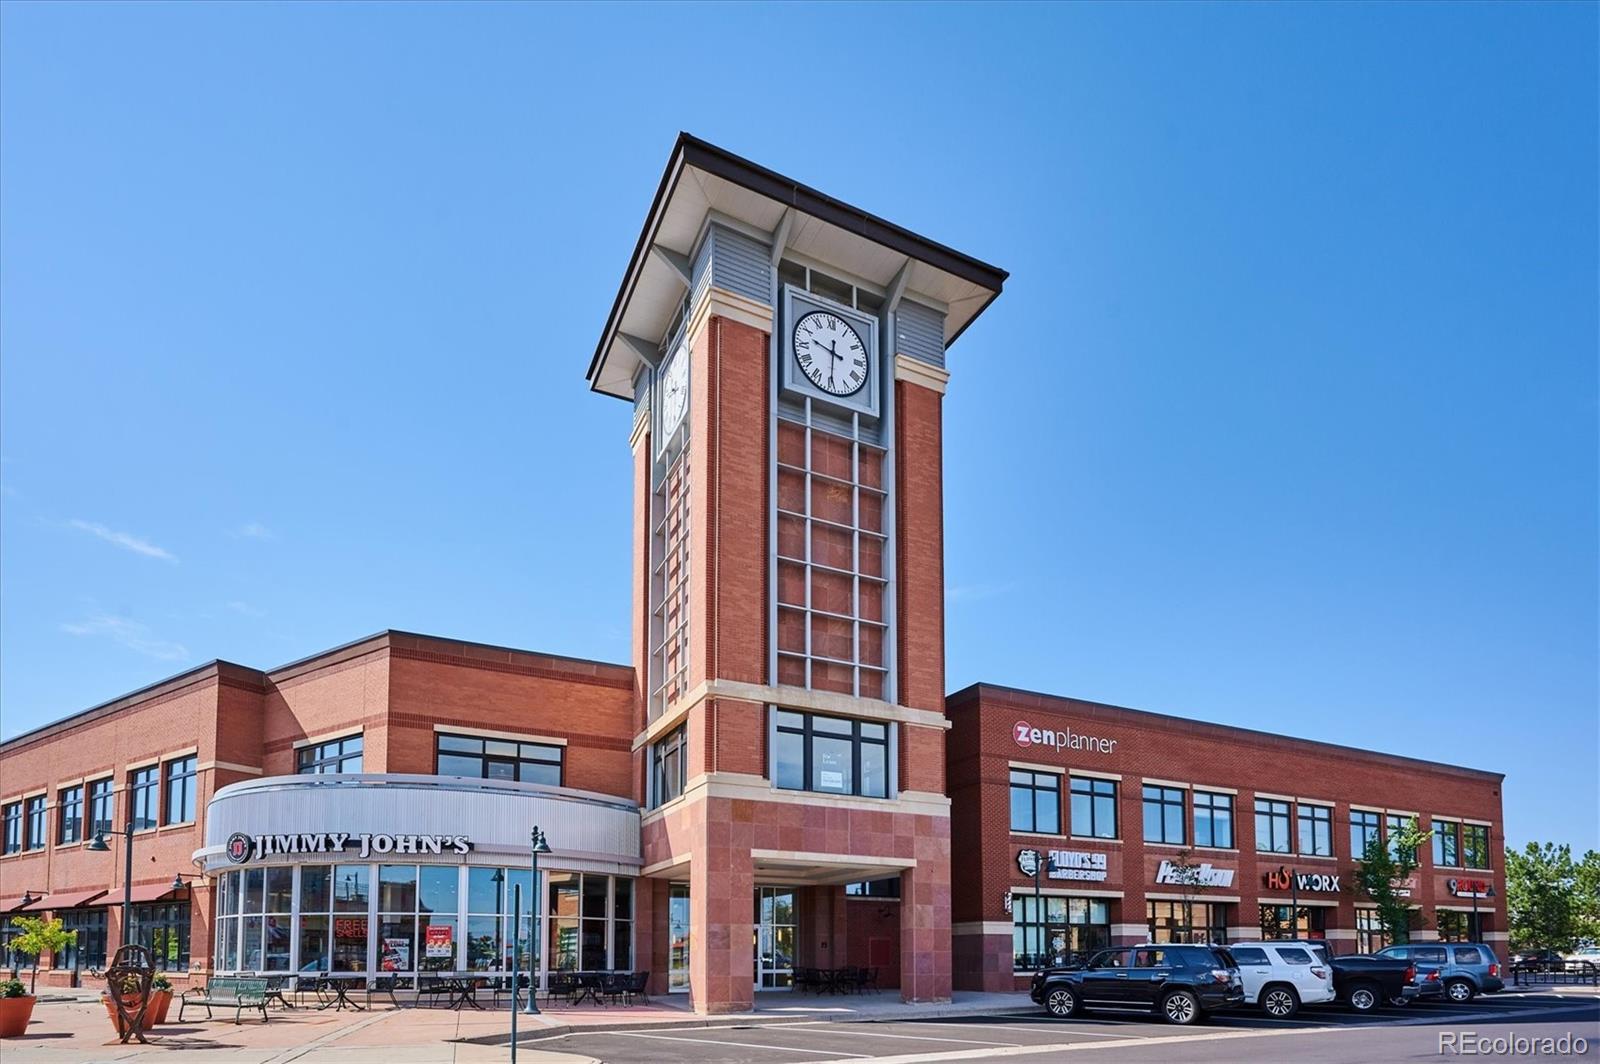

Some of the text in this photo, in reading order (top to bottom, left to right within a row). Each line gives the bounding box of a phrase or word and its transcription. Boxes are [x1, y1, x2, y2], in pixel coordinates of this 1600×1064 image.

[256, 834, 348, 860] JIMMY
[360, 834, 470, 858] JOHN'S
[335, 919, 368, 930] FREE
